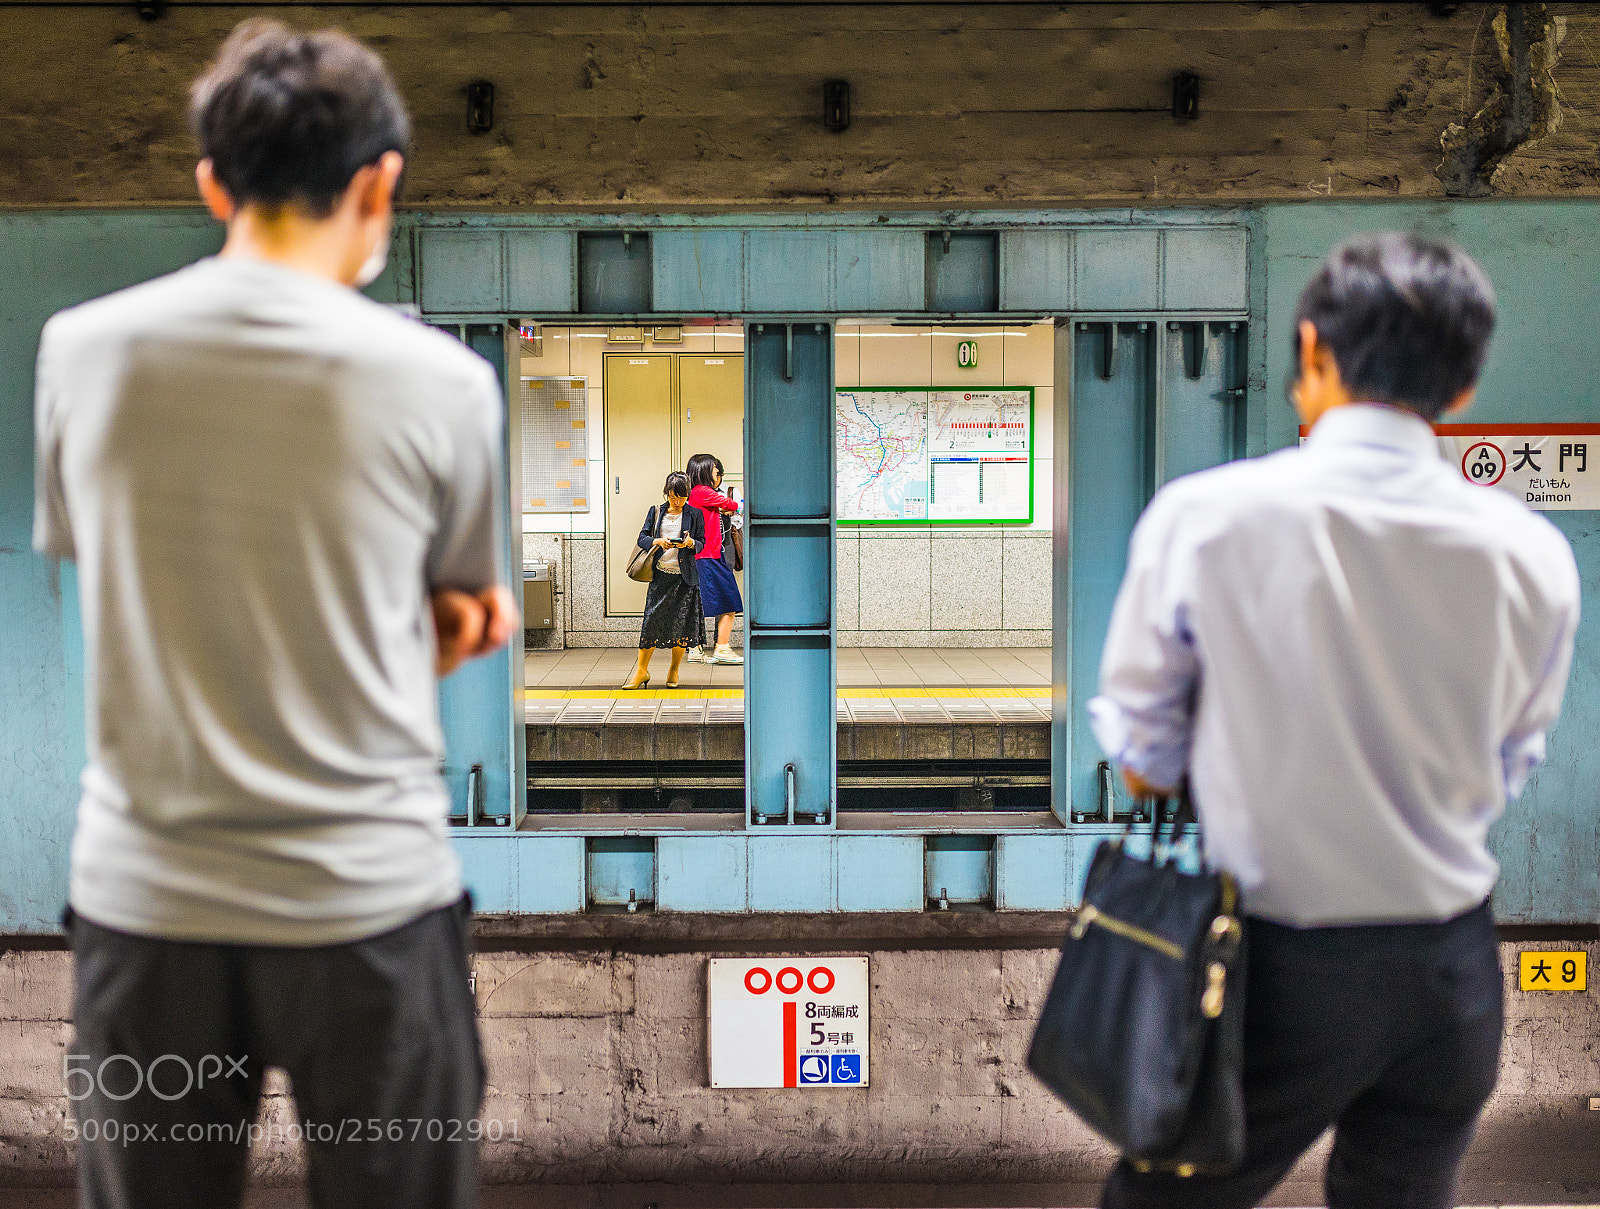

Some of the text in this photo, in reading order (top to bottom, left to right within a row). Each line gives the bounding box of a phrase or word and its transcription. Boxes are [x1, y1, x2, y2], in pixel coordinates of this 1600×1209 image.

[949, 440, 955, 449] 2
[1020, 440, 1025, 449] 1
[1478, 447, 1490, 460] A
[1512, 442, 1588, 473] 大門
[1471, 462, 1497, 479] 09
[1528, 478, 1571, 489] だいもん
[1526, 492, 1572, 502] Daimon
[805, 1002, 859, 1019] 8両編成
[810, 1022, 854, 1046] 5号車
